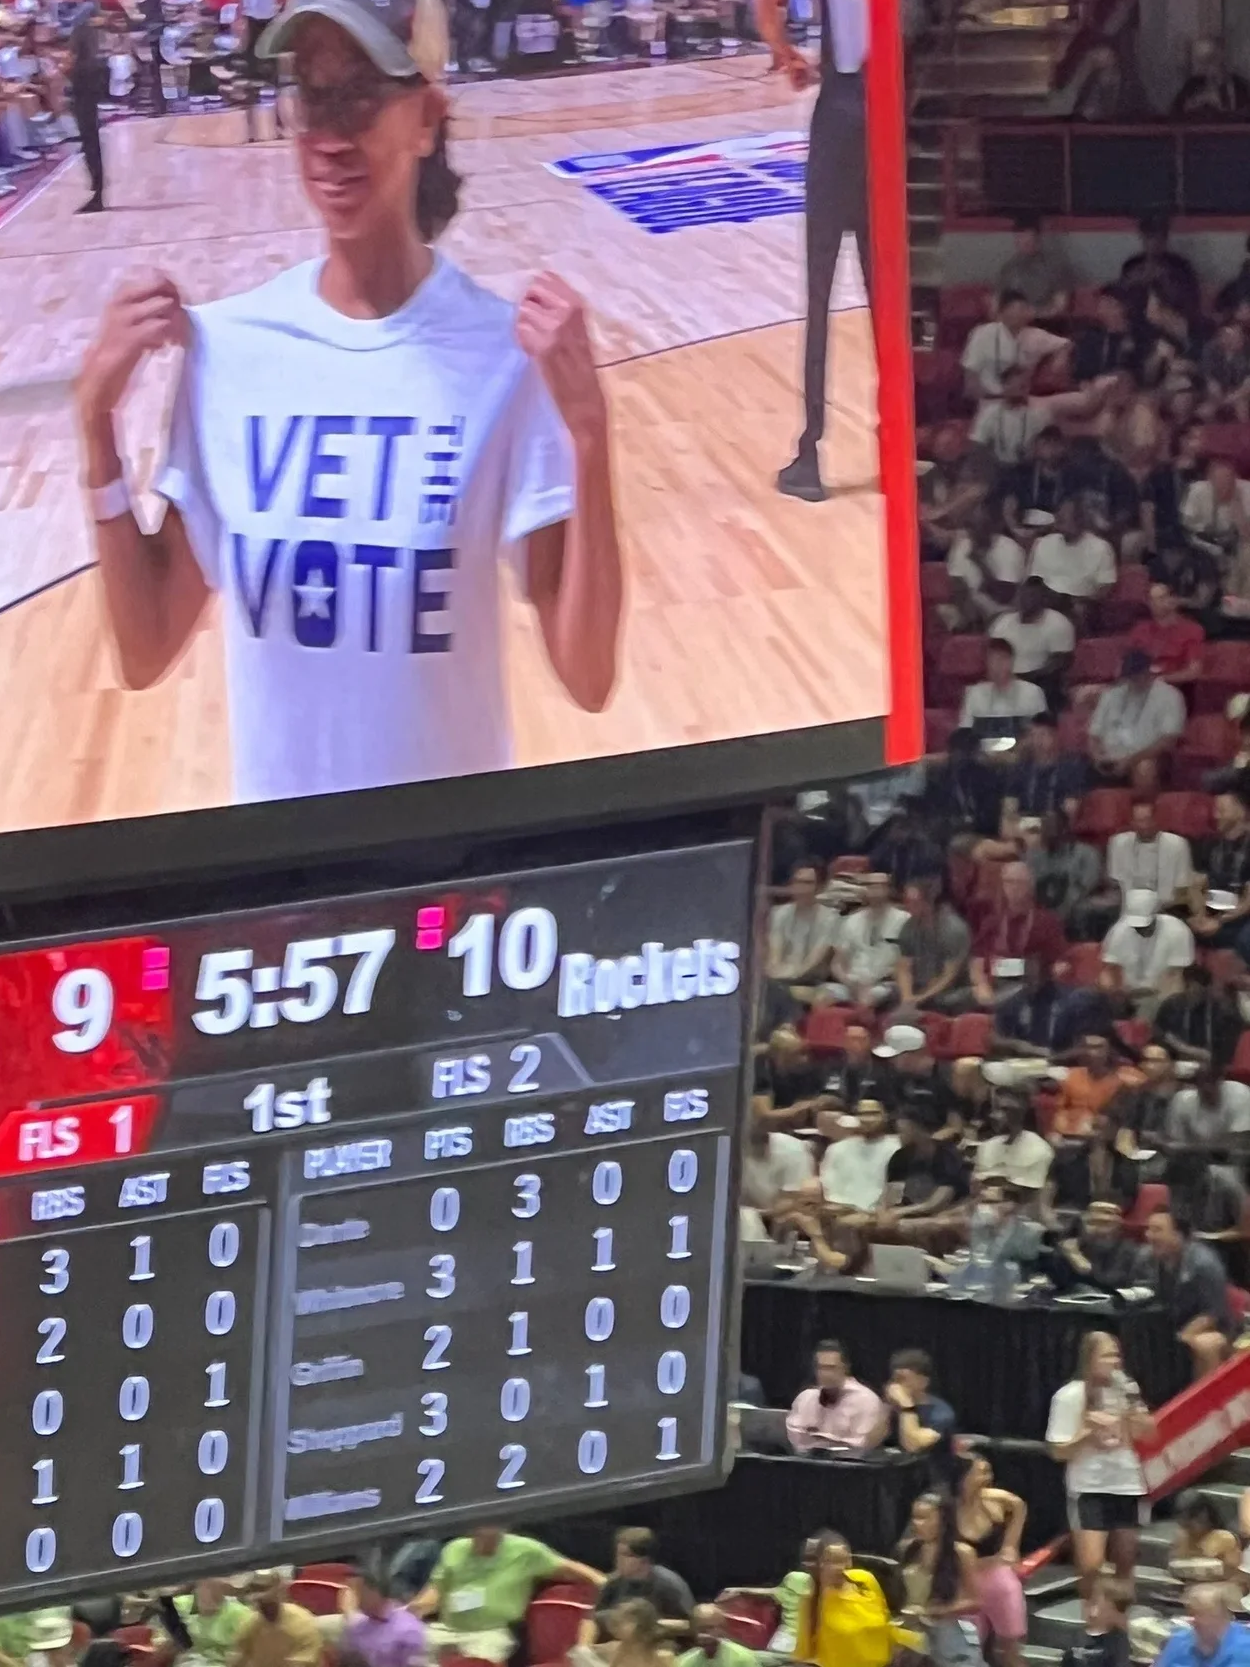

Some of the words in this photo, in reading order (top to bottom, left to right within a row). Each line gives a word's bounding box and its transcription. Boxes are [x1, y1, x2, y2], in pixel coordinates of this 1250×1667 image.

[244, 415, 420, 522] VET
[229, 532, 459, 654] VOTE
[191, 928, 396, 1035] 5:57
[447, 906, 559, 997] 10
[557, 938, 740, 1018] Rockets
[52, 968, 113, 1053] 9
[244, 1077, 333, 1133] 1st
[506, 1043, 542, 1094] 2
[109, 1104, 134, 1153] 1
[430, 1187, 460, 1232] 0
[511, 1173, 542, 1218] 3
[592, 1160, 623, 1205] 0
[668, 1149, 698, 1193] 0
[39, 1248, 70, 1295] 3
[128, 1235, 156, 1281] 1
[208, 1221, 240, 1268] 0
[425, 1253, 456, 1299] 3
[510, 1240, 536, 1285] 1
[590, 1226, 617, 1272] 1
[666, 1215, 692, 1259] 1
[35, 1317, 67, 1364] 2
[122, 1303, 154, 1349] 0
[205, 1290, 236, 1336] 0
[421, 1324, 453, 1370] 2
[506, 1311, 533, 1356] 1
[584, 1297, 615, 1342] 0
[660, 1284, 691, 1329] 0
[32, 1390, 64, 1436] 0
[119, 1375, 150, 1421] 0
[203, 1361, 231, 1408] 1
[418, 1391, 448, 1437] 3
[500, 1377, 531, 1422] 0
[583, 1363, 609, 1408] 1
[656, 1350, 687, 1395] 0
[31, 1458, 59, 1505] 1
[117, 1443, 145, 1490] 1
[197, 1429, 229, 1475] 0
[415, 1458, 445, 1504] 2
[496, 1443, 527, 1489] 2
[577, 1429, 608, 1474] 0
[655, 1417, 682, 1461] 1
[25, 1527, 57, 1573] 0
[111, 1512, 143, 1558] 0
[194, 1497, 225, 1543] 0
